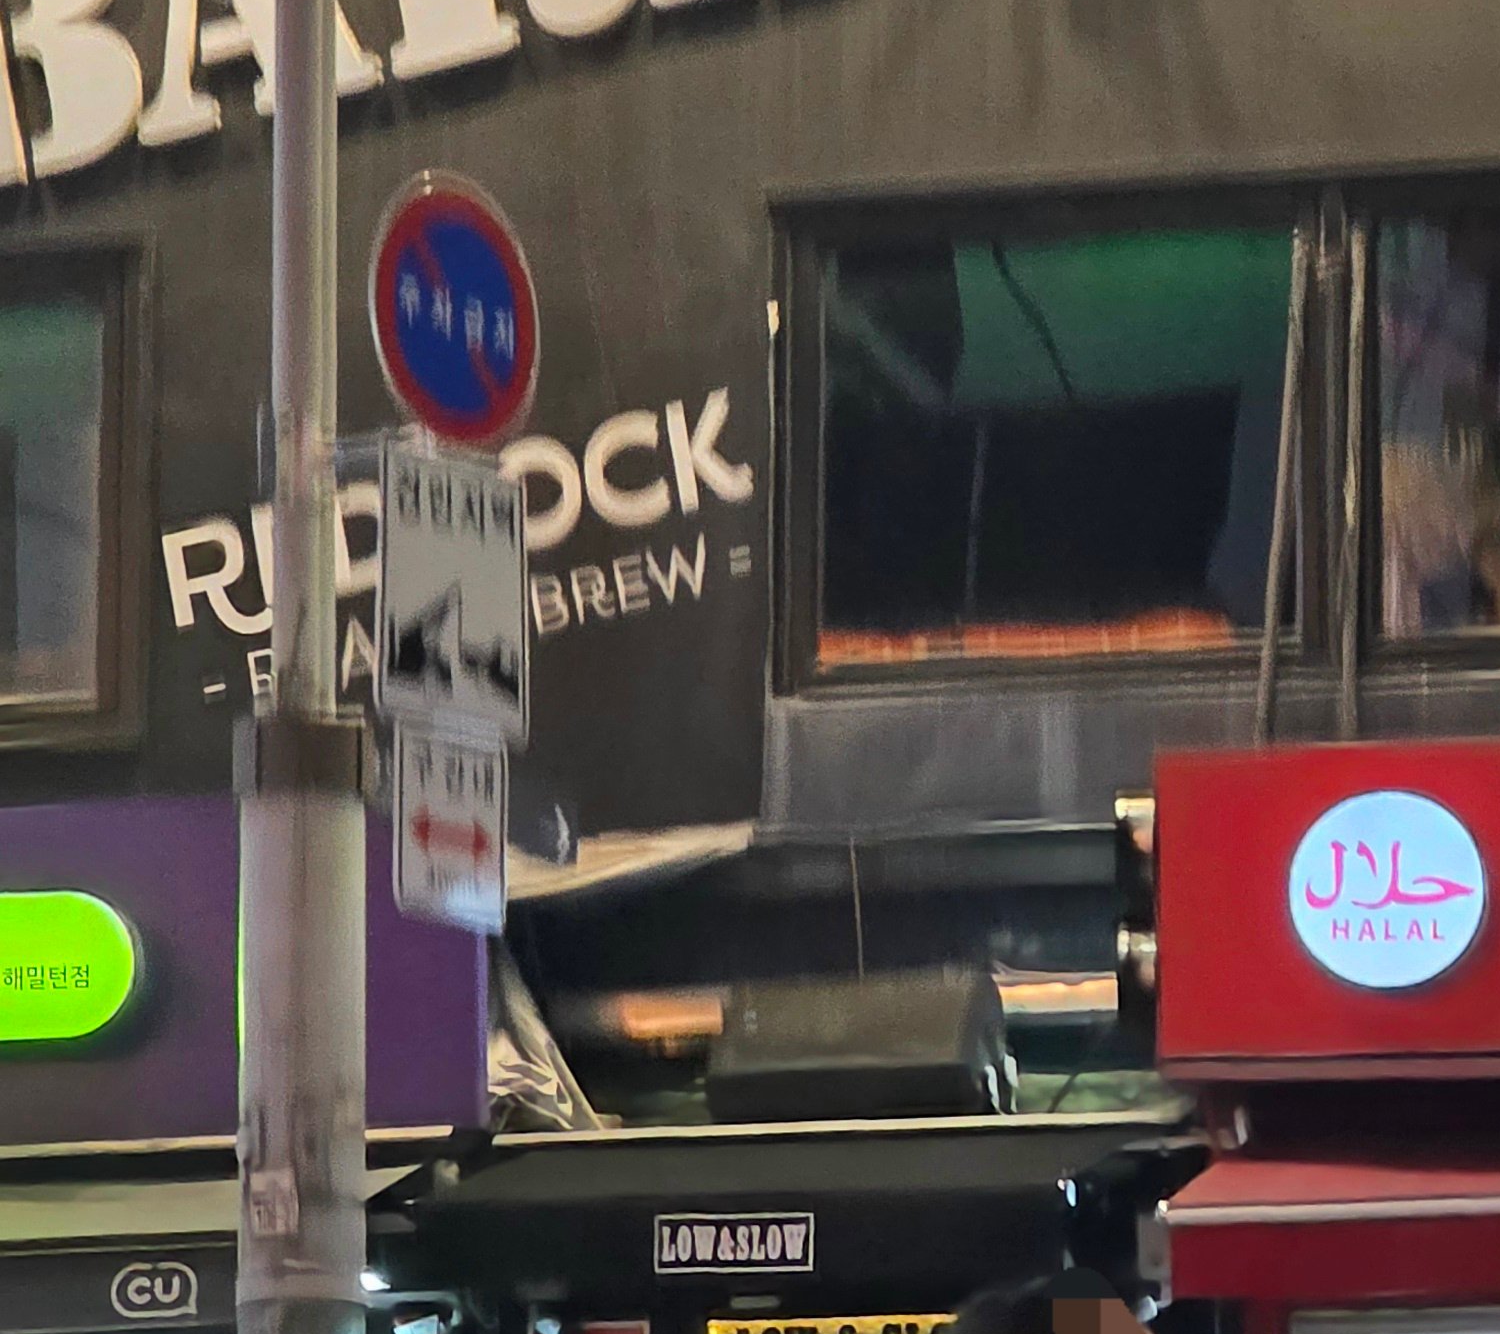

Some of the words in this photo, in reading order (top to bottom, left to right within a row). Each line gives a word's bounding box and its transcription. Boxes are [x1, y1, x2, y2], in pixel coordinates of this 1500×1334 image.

[162, 386, 754, 635] RDOCK
[531, 532, 706, 635] BREW
[1305, 839, 1475, 910] حلال
[1330, 918, 1446, 942] HALAL
[2, 964, 90, 991] 해밀턴점
[127, 1274, 180, 1305] CU
